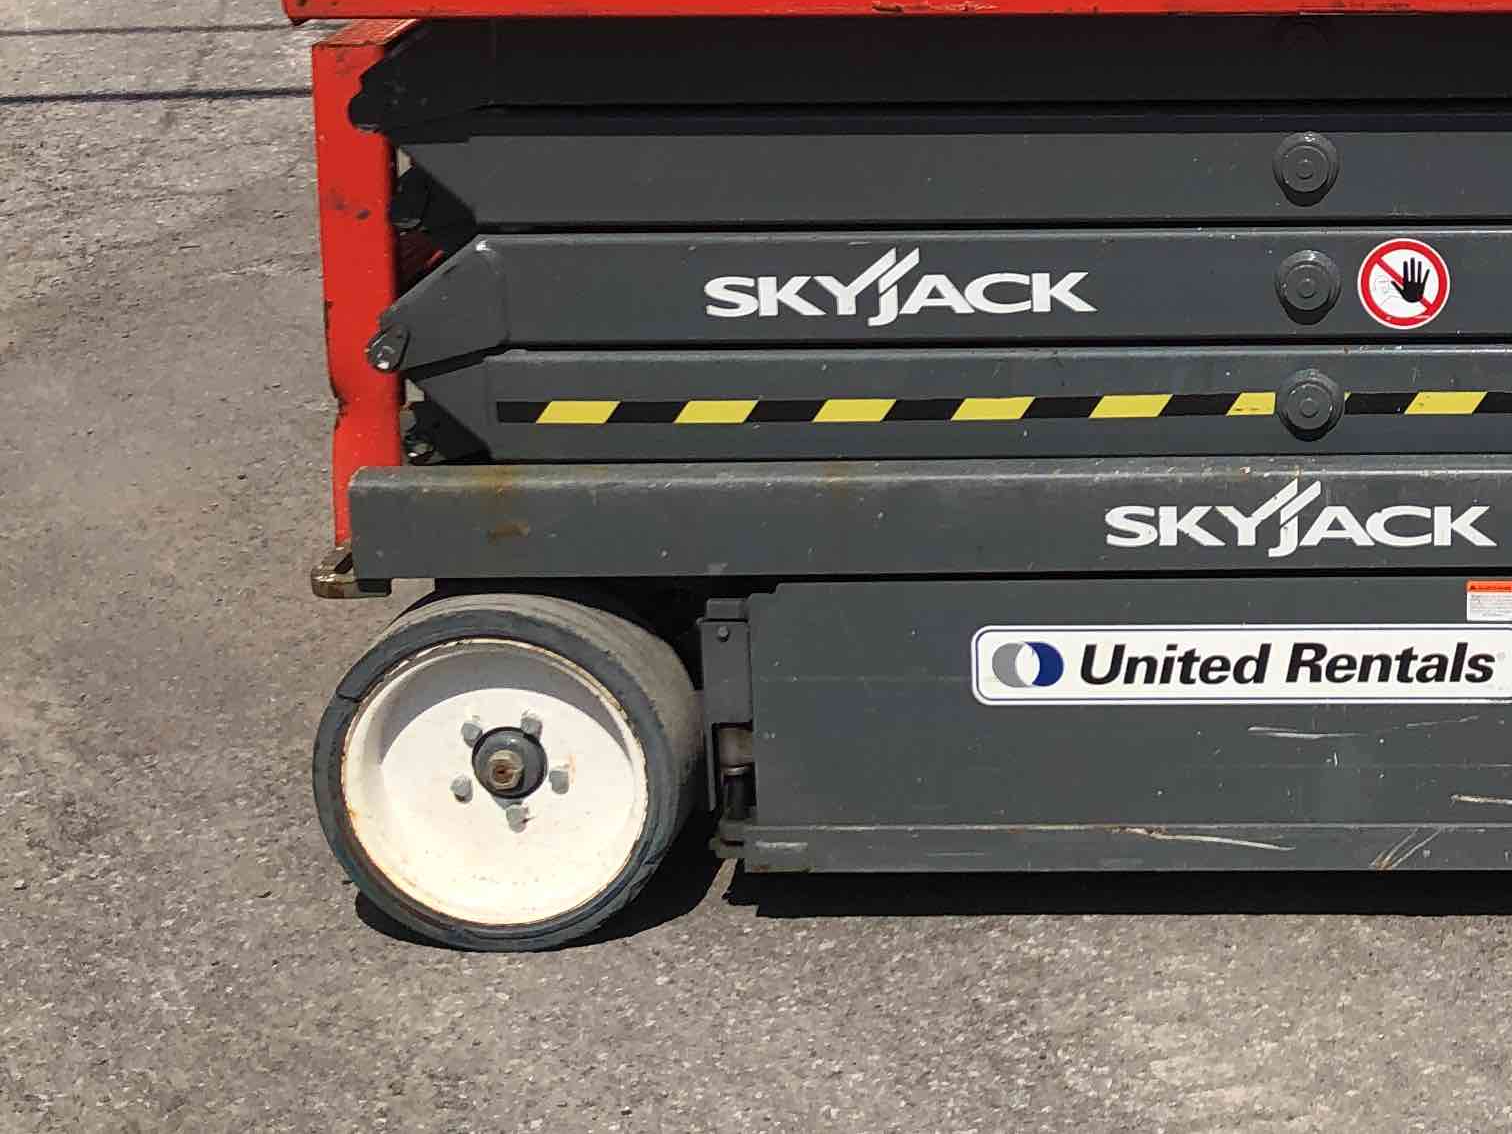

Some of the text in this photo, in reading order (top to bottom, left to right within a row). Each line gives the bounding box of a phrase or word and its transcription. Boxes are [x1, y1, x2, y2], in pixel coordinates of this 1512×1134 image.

[704, 247, 1098, 327] SKYJACK
[1105, 478, 1498, 558] SKYJACK
[1081, 642, 1495, 685] United Rentals
